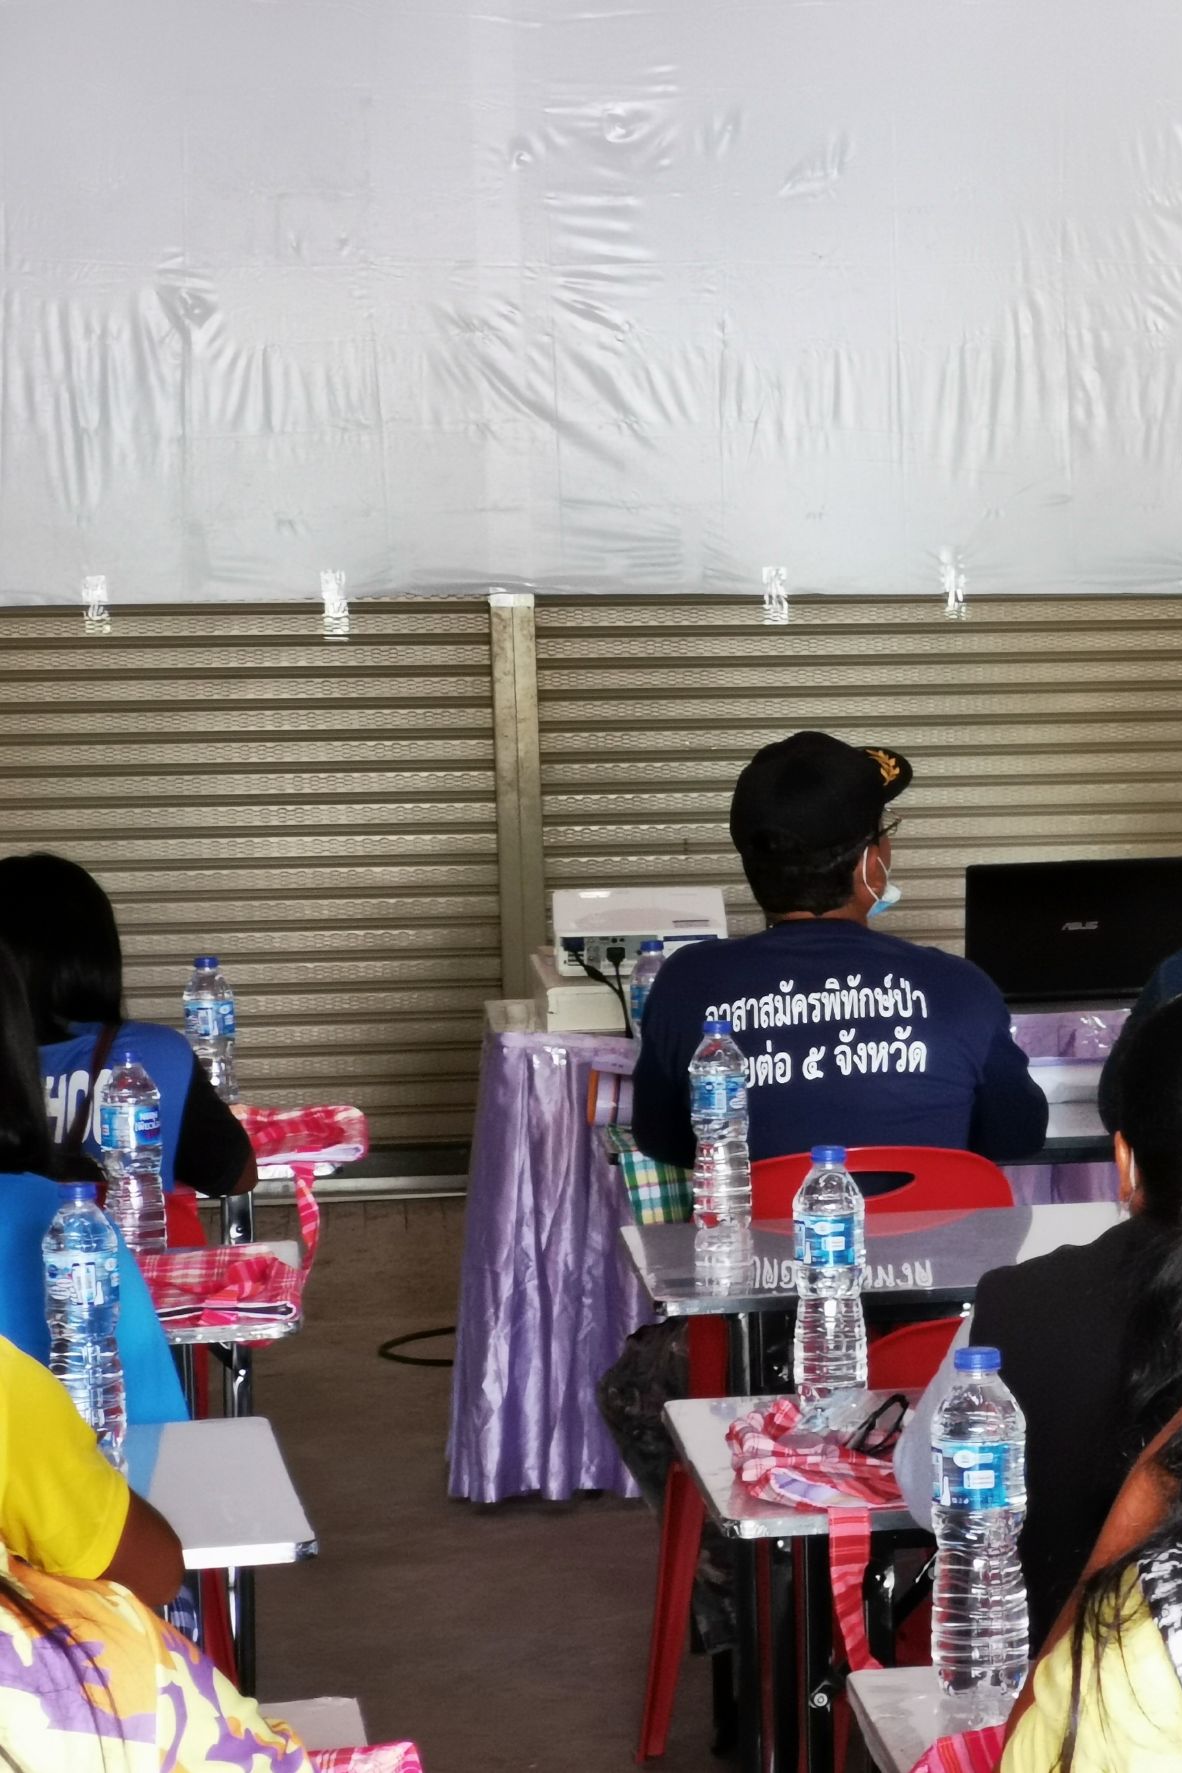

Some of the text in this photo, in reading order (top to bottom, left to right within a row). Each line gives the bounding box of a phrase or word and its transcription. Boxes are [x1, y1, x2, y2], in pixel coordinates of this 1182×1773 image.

[802, 1046, 826, 1081] ๕
[834, 1025, 928, 1076] จังหวัด
